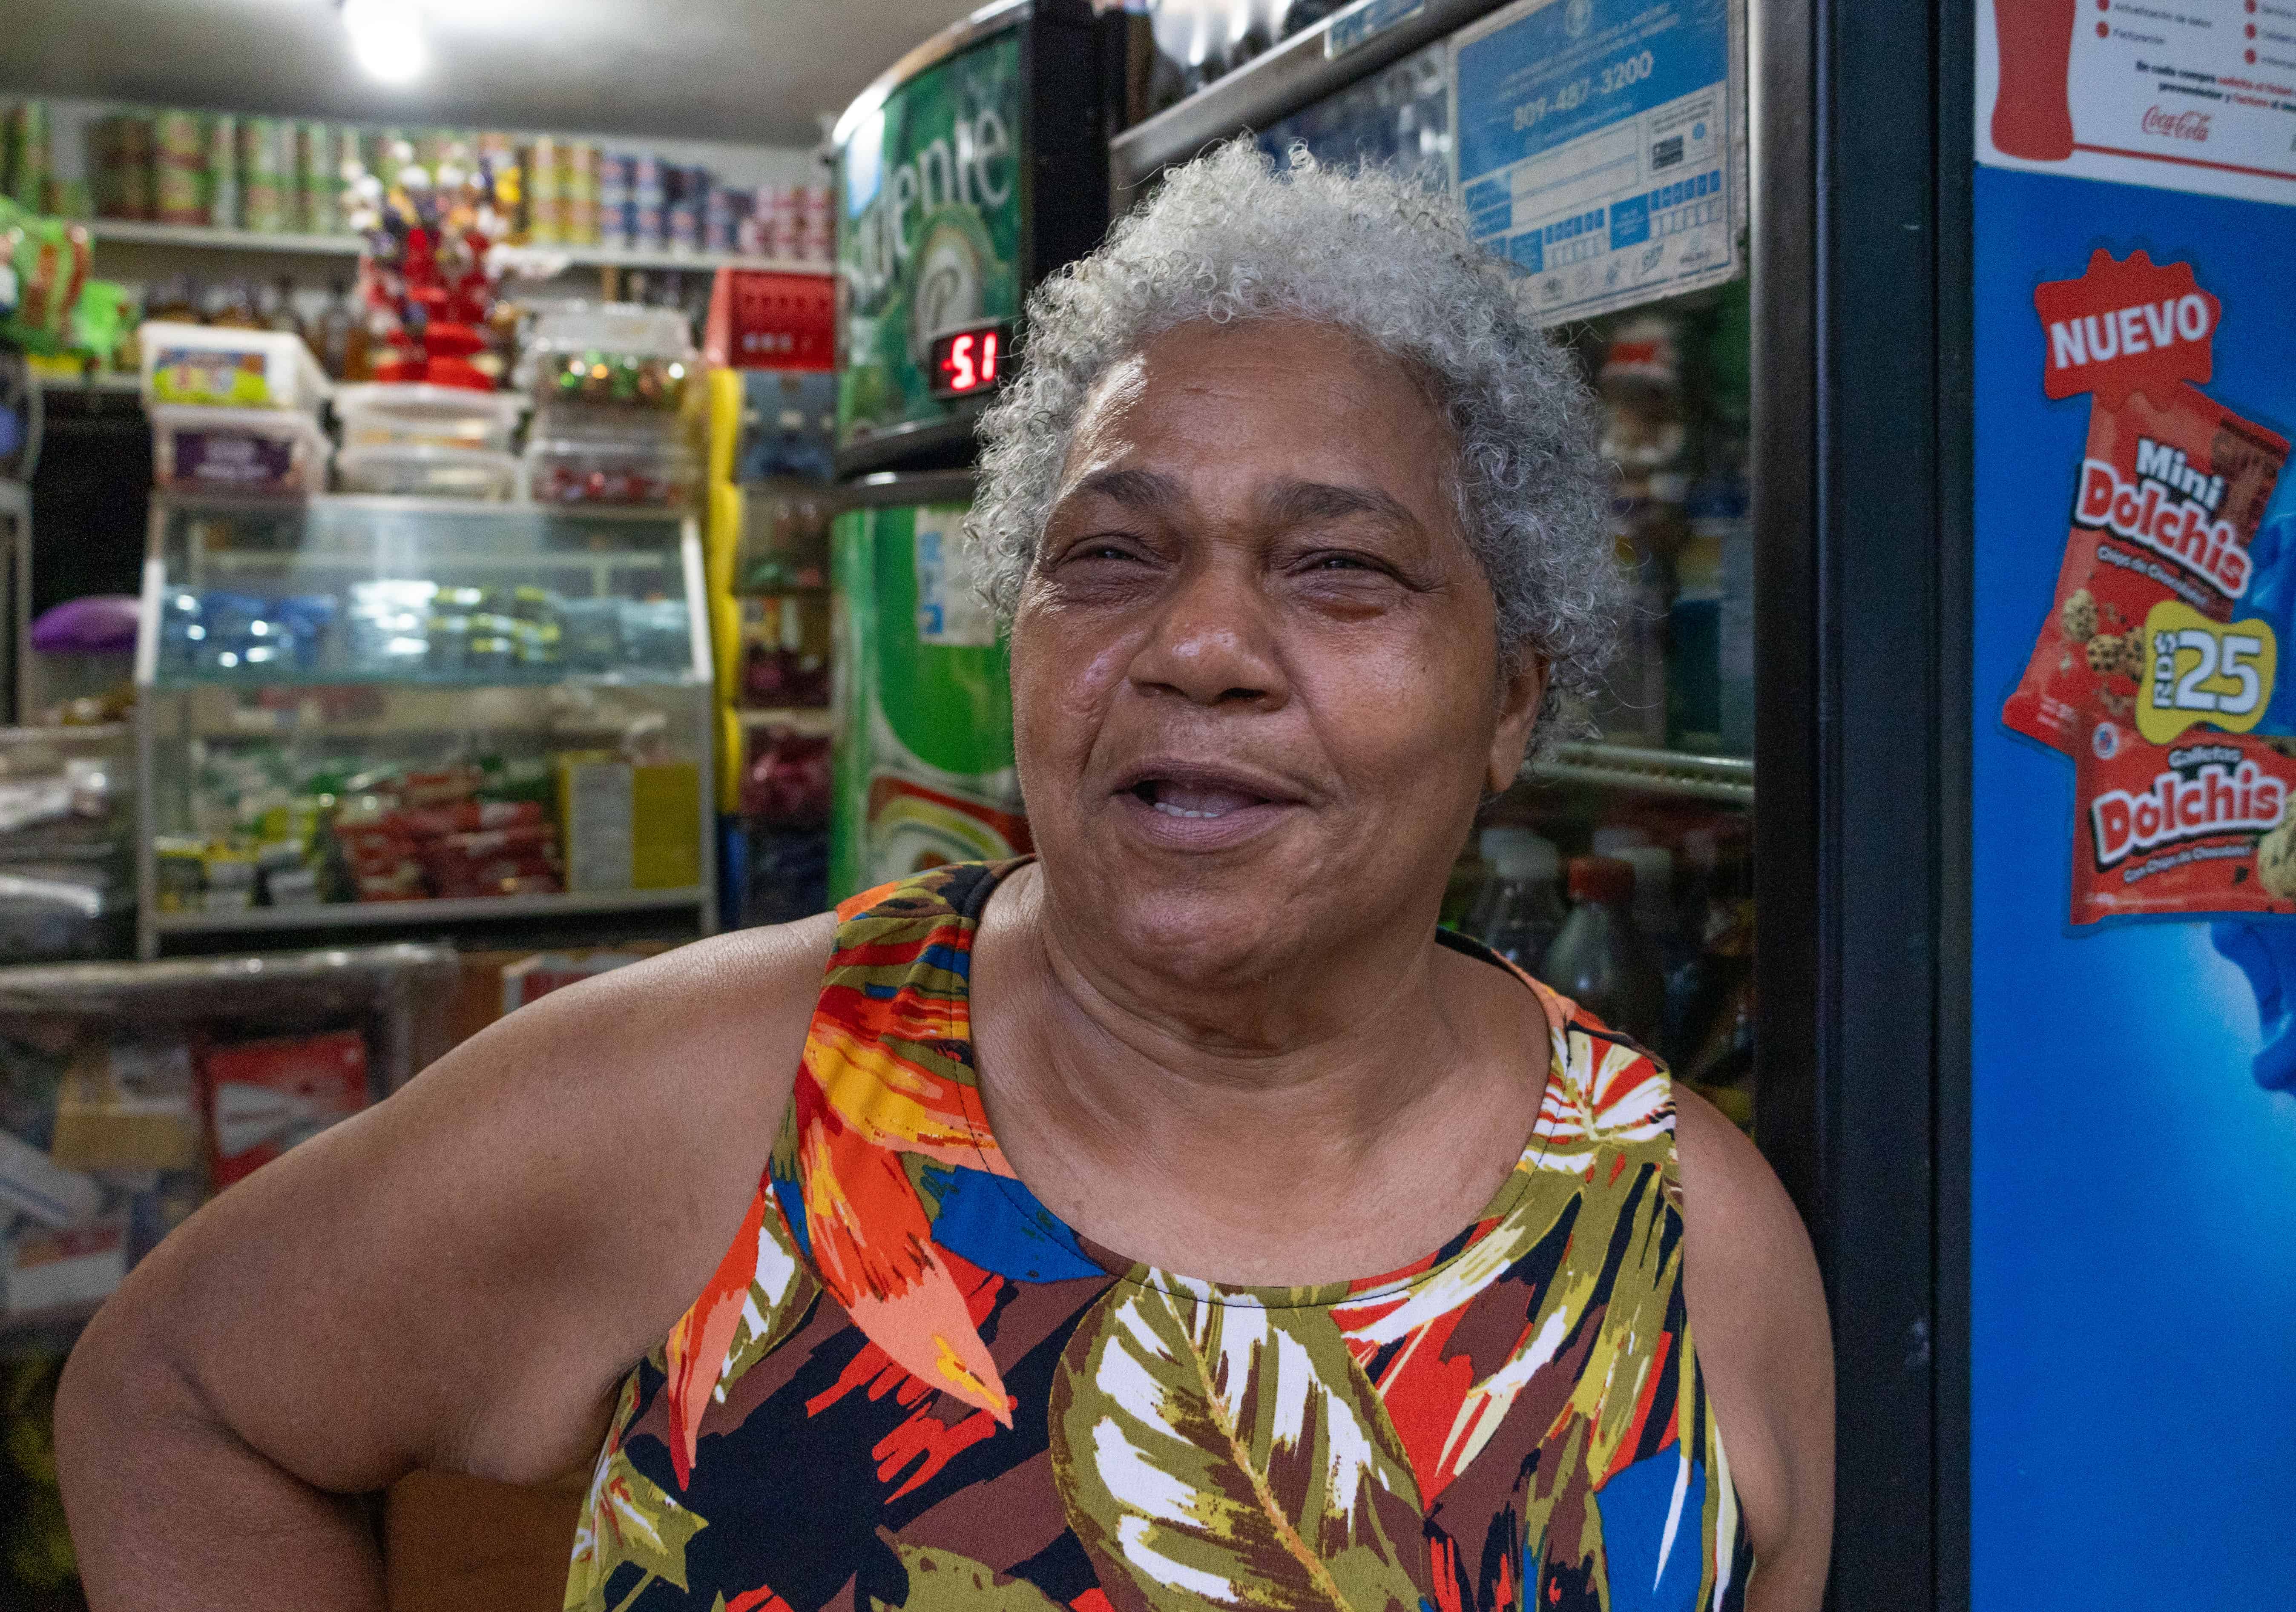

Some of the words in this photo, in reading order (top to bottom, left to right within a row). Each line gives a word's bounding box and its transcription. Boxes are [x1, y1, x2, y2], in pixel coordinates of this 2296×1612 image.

[2050, 293, 2210, 369] NUEVO
[2136, 439, 2225, 511] Mini
[2077, 460, 2251, 599] Dolchis
[2175, 630, 2262, 714] 25
[2168, 746, 2243, 768] Galletas
[2092, 760, 2285, 865] Dolchis
